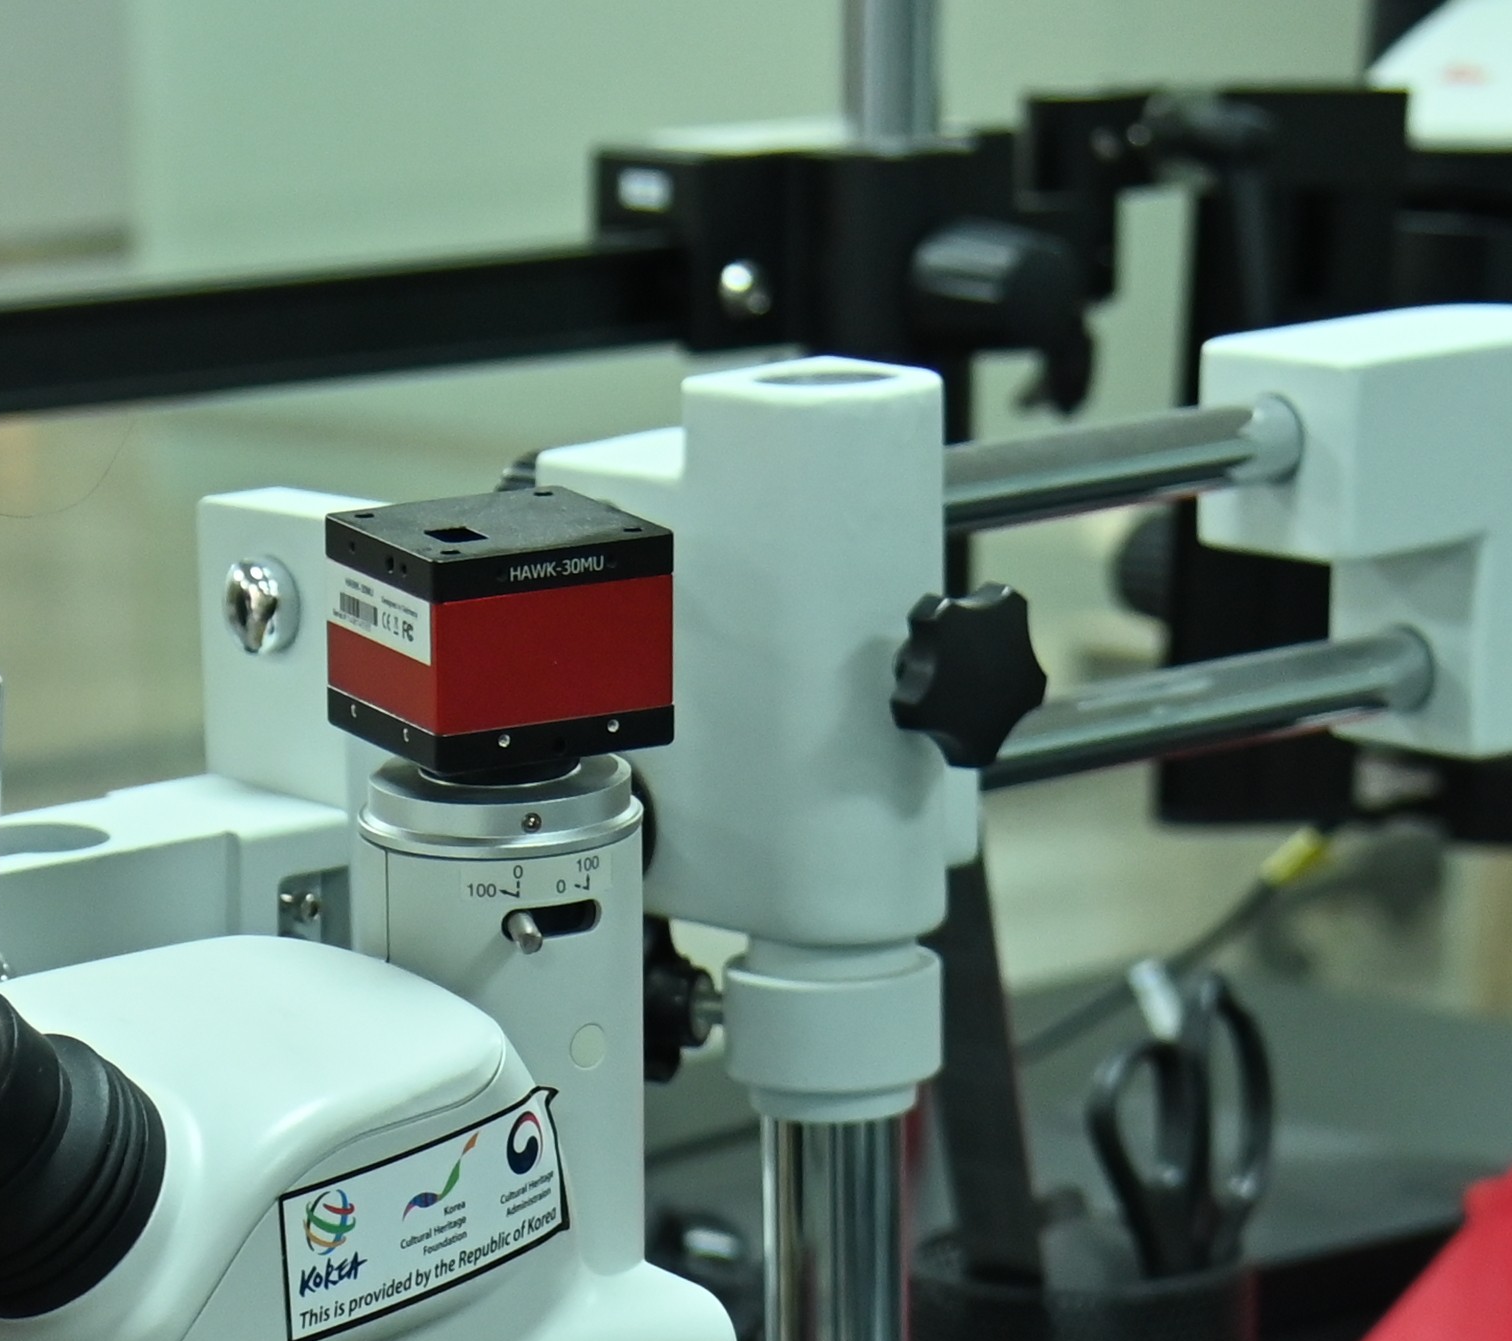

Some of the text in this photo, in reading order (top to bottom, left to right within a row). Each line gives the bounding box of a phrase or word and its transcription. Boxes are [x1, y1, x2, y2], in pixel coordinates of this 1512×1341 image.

[509, 555, 605, 582] HAWK-30MU
[513, 865, 523, 879] 0
[577, 855, 600, 872] 100
[467, 883, 497, 898] 100
[556, 879, 566, 894] 0
[500, 1183, 528, 1204] Cultural
[444, 1201, 466, 1216] Korea
[400, 1216, 467, 1250] Cultural Heritage
[423, 1231, 468, 1256] Foundation
[300, 1207, 557, 1329] This is provided by the Republic of Korea
